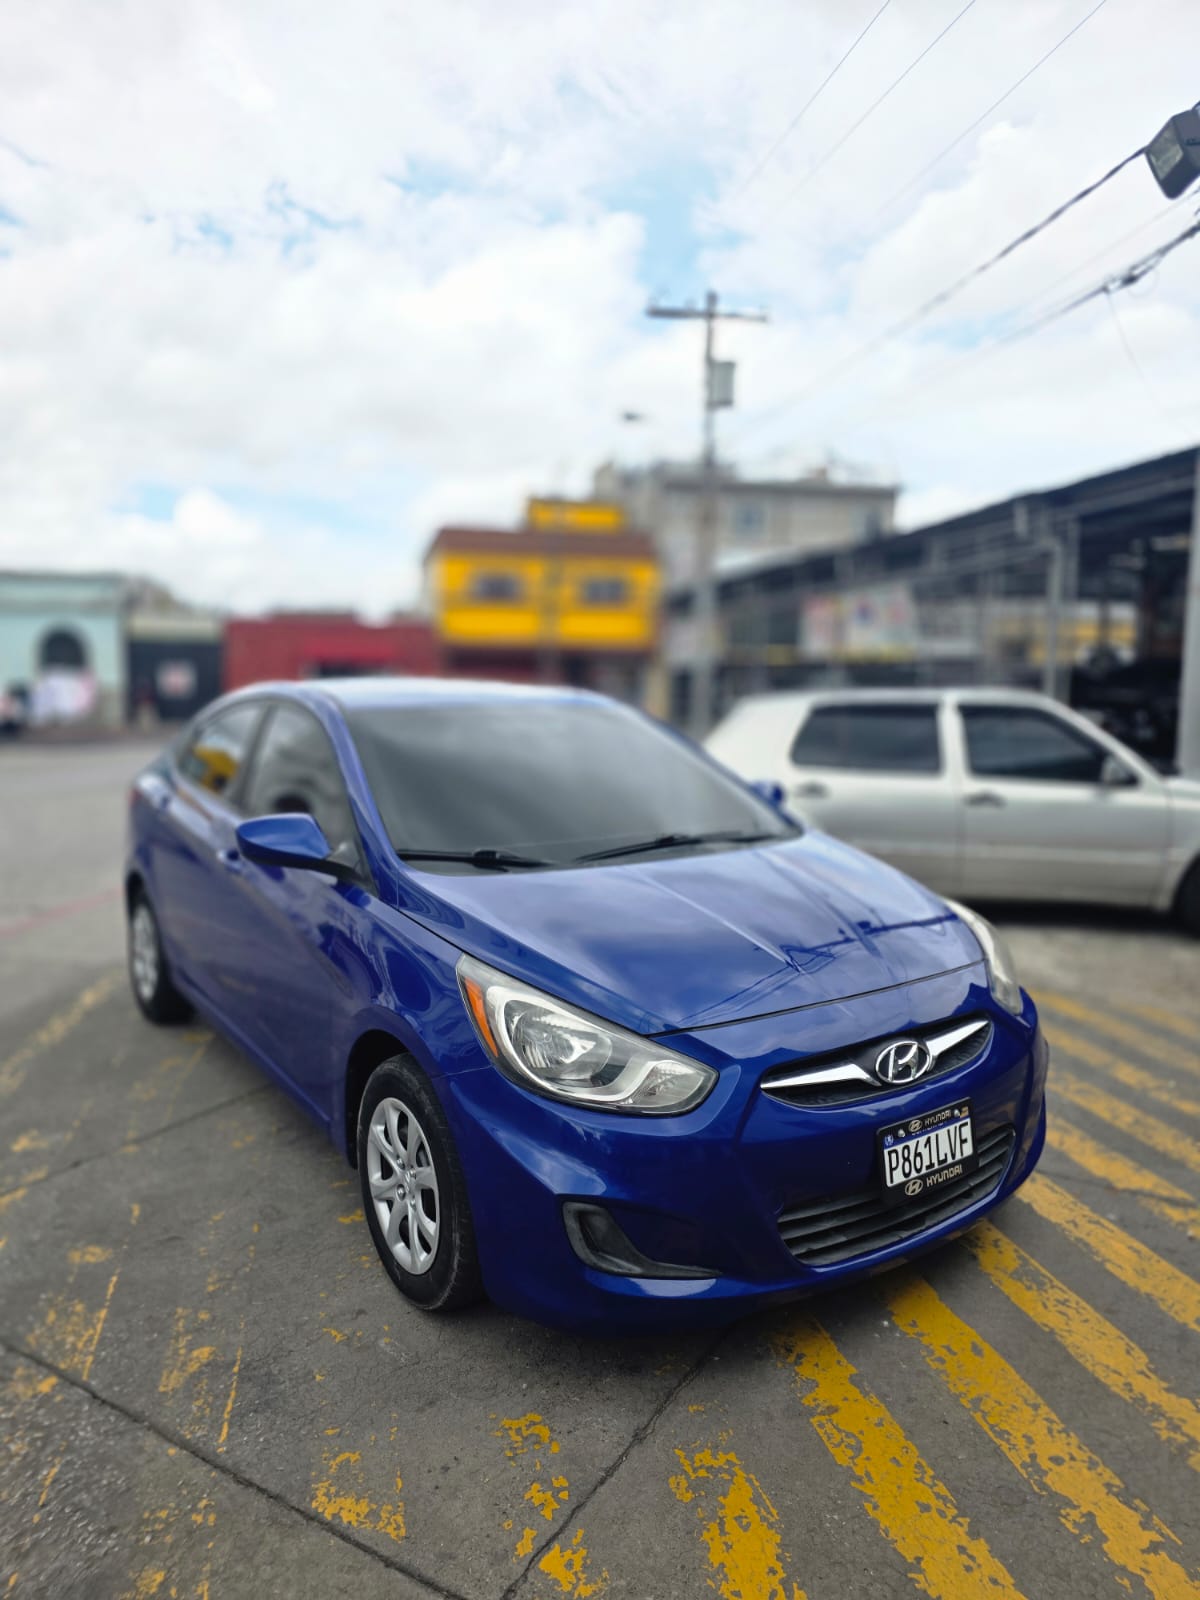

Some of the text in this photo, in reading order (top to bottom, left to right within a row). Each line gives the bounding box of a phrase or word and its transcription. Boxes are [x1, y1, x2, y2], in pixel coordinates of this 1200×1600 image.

[924, 1109, 952, 1127] HYUNDAI
[887, 1121, 969, 1185] P861LVF
[926, 1164, 963, 1188] HYUNDAI
